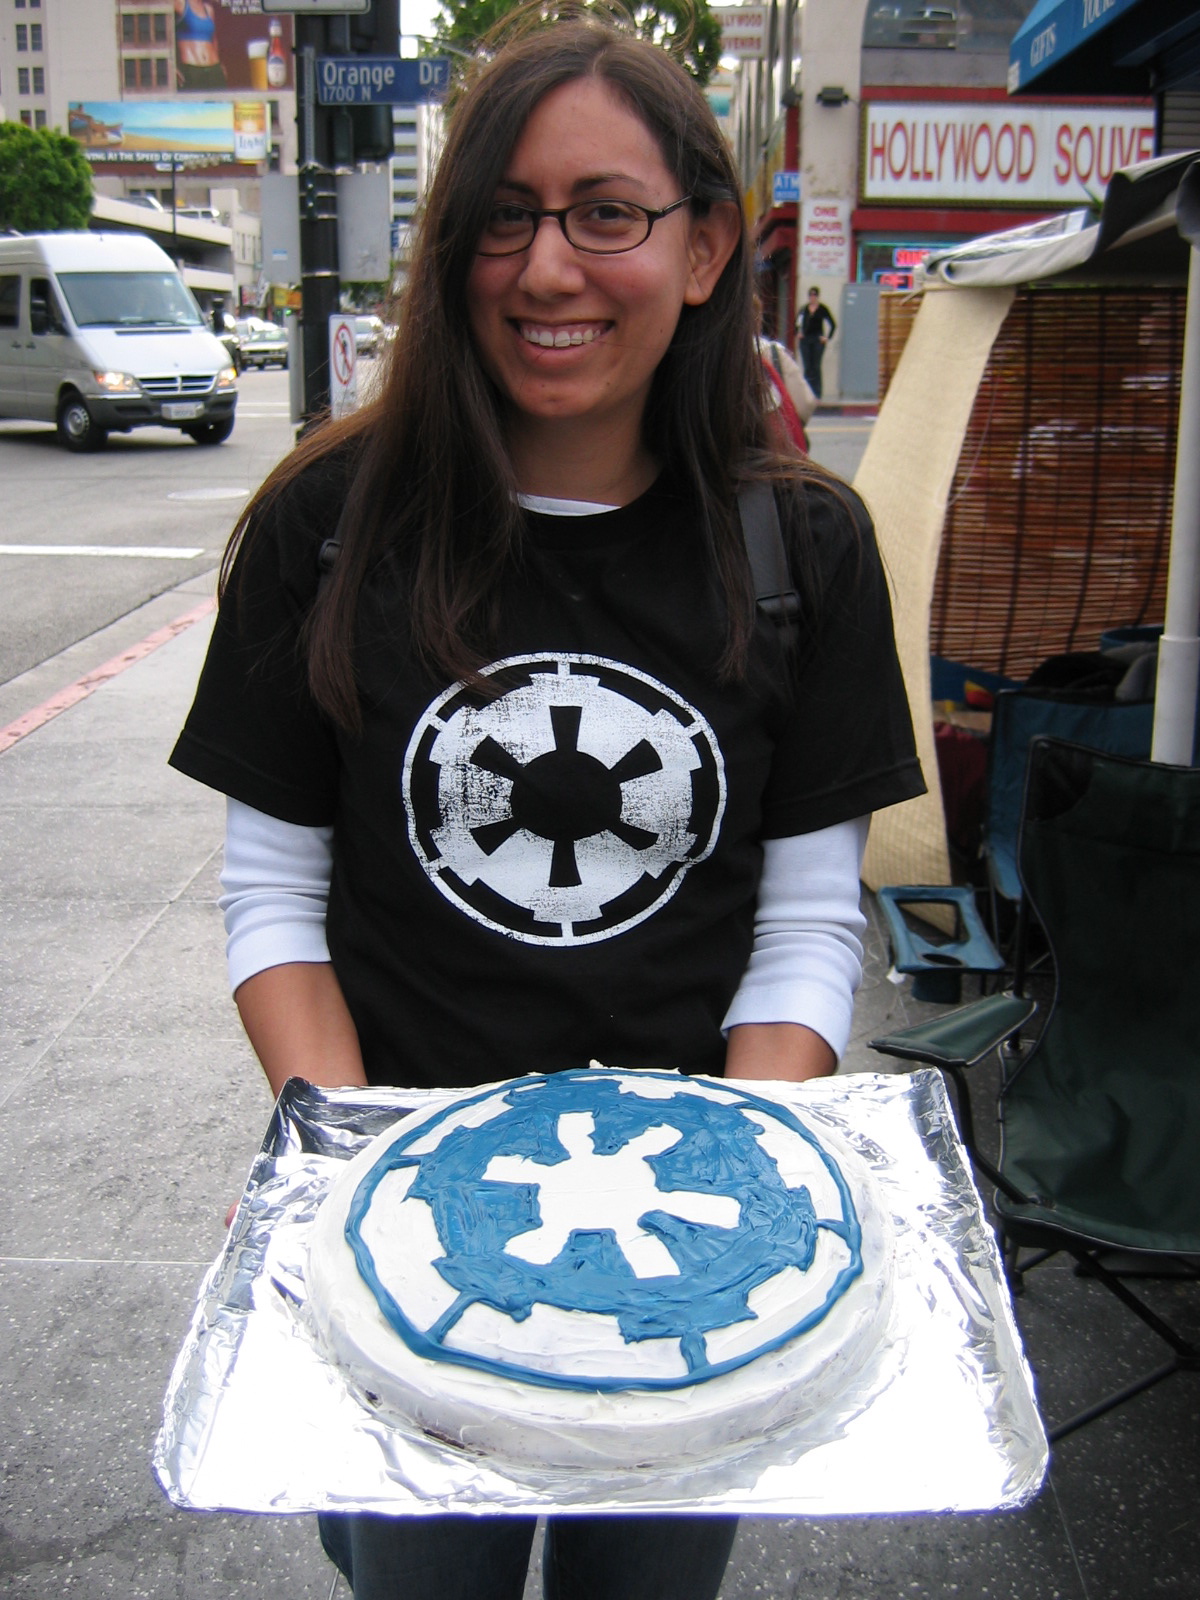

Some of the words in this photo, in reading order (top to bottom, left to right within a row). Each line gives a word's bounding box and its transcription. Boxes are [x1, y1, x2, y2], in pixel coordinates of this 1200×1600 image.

[711, 14, 762, 26] OLLYWOOD
[1030, 22, 1056, 68] GIFTS
[323, 61, 395, 92] Orange
[420, 61, 442, 85] Dr
[323, 87, 354, 101] 1700
[362, 87, 371, 100] N
[136, 152, 160, 162] SPEED
[869, 121, 1036, 183] HOLLYWOOD
[1054, 123, 1154, 185] SOUVE
[775, 175, 800, 188] ATM
[813, 206, 838, 217] ONE
[808, 221, 842, 232] HOUR
[804, 235, 845, 246] PHOTO
